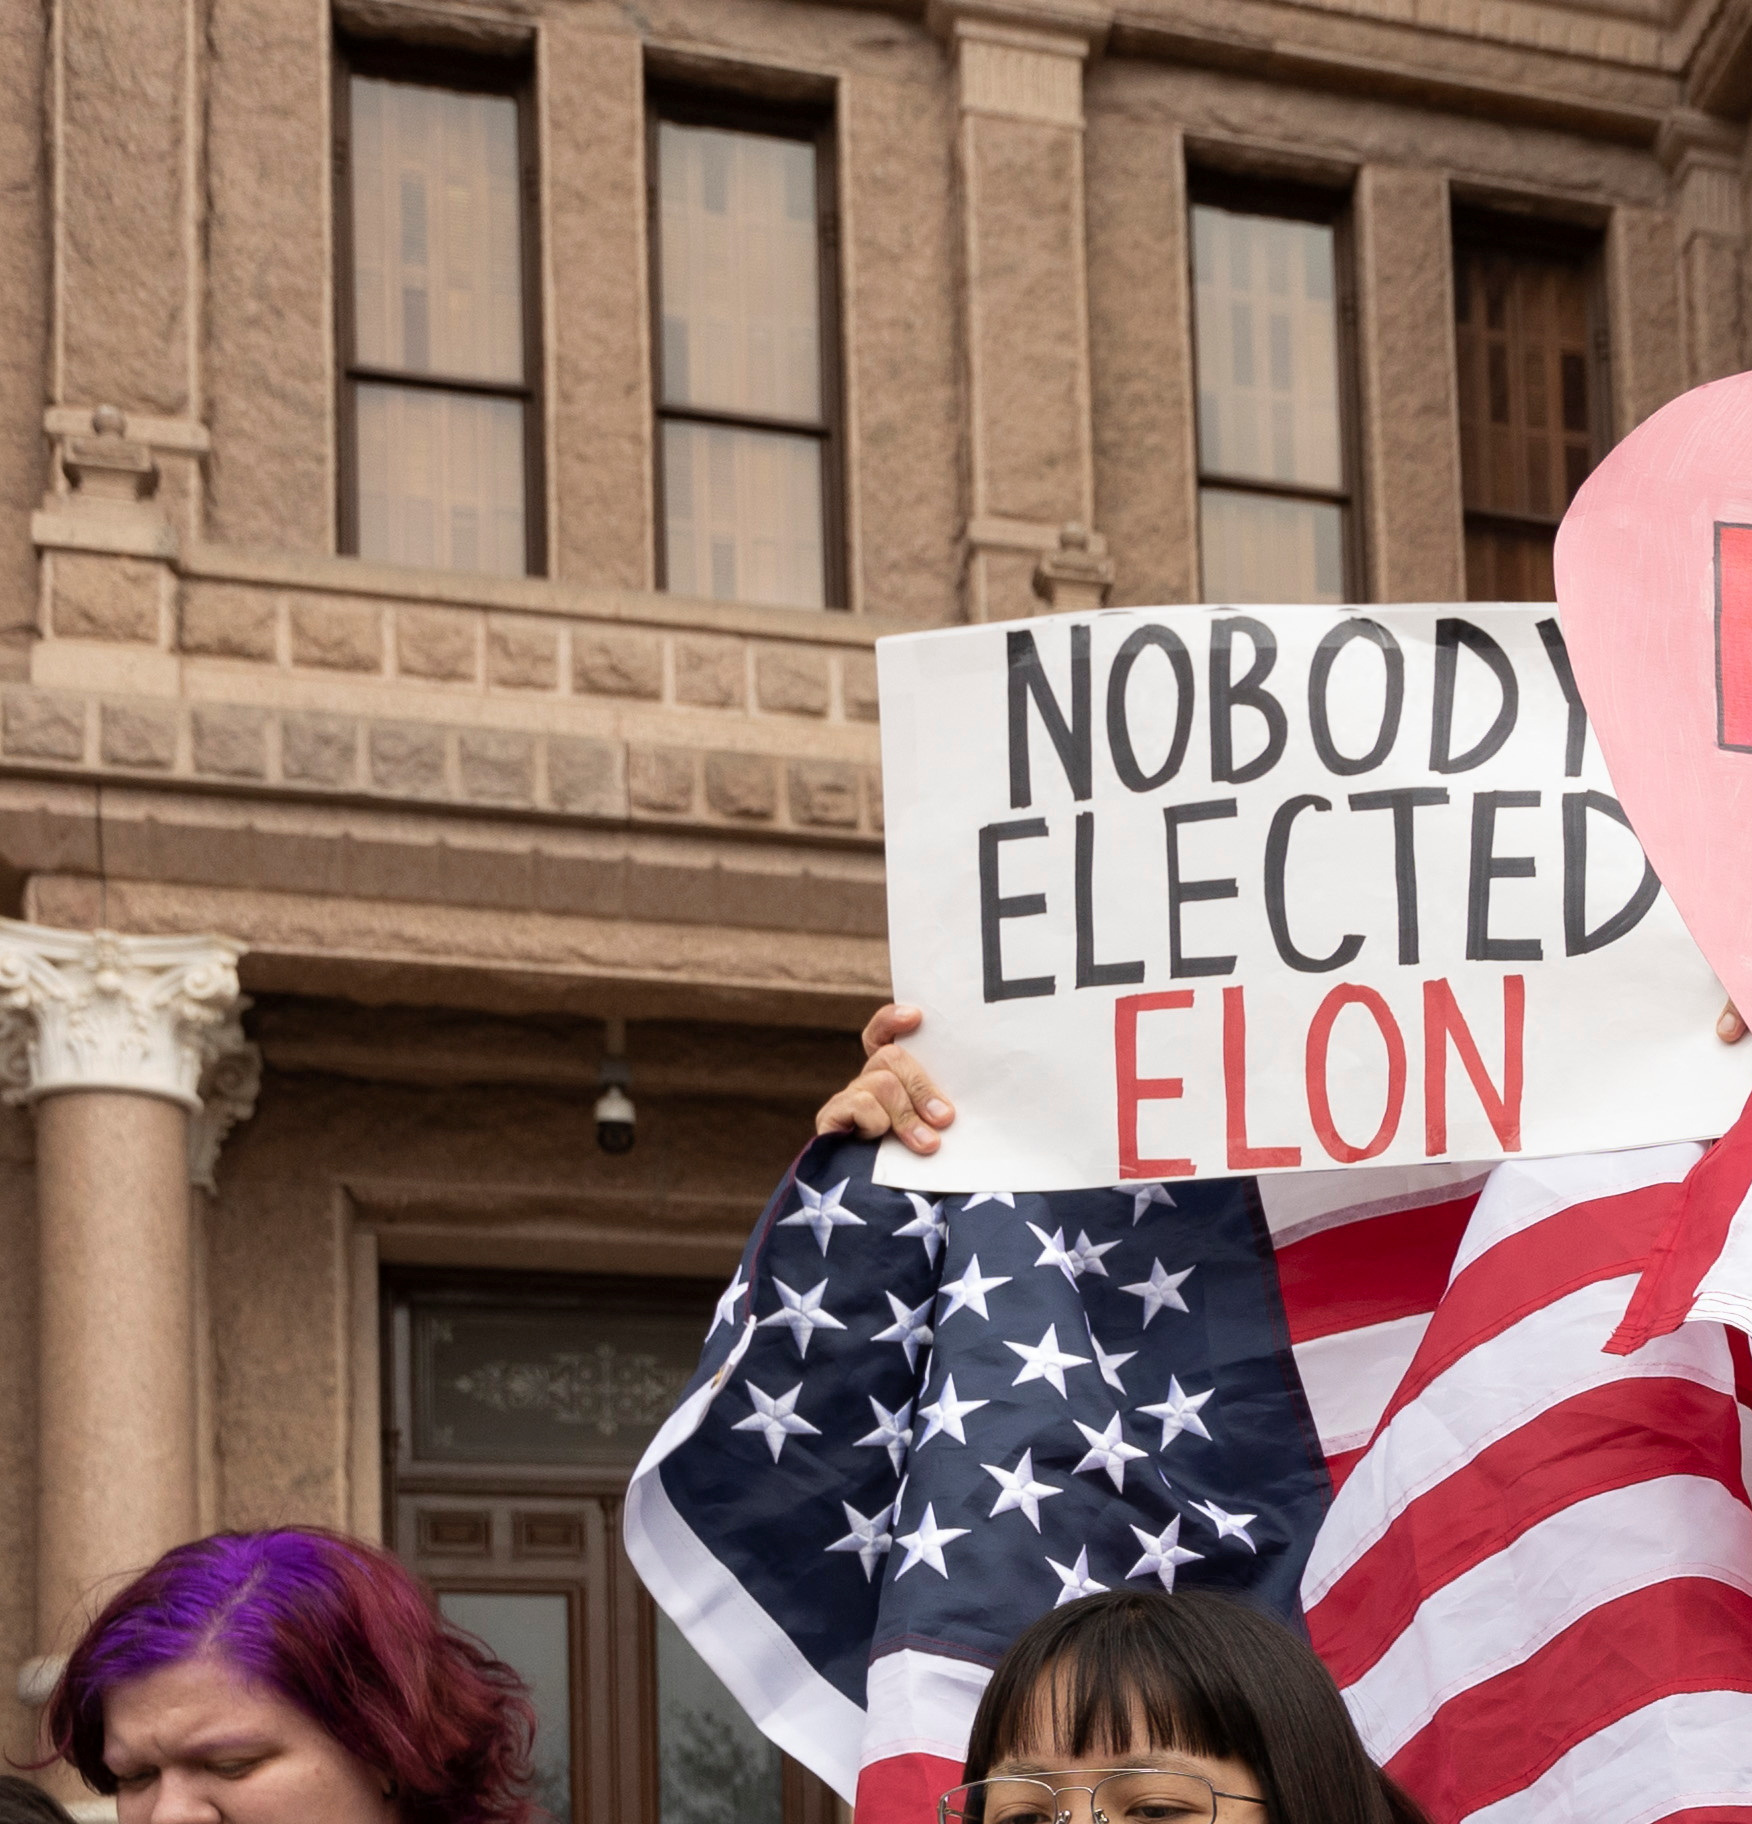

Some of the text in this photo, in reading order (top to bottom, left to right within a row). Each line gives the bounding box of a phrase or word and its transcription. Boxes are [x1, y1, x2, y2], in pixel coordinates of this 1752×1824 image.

[1006, 615, 1587, 809] NOBODY
[979, 787, 1662, 1002] ELECTED
[1115, 974, 1526, 1179] ELON
